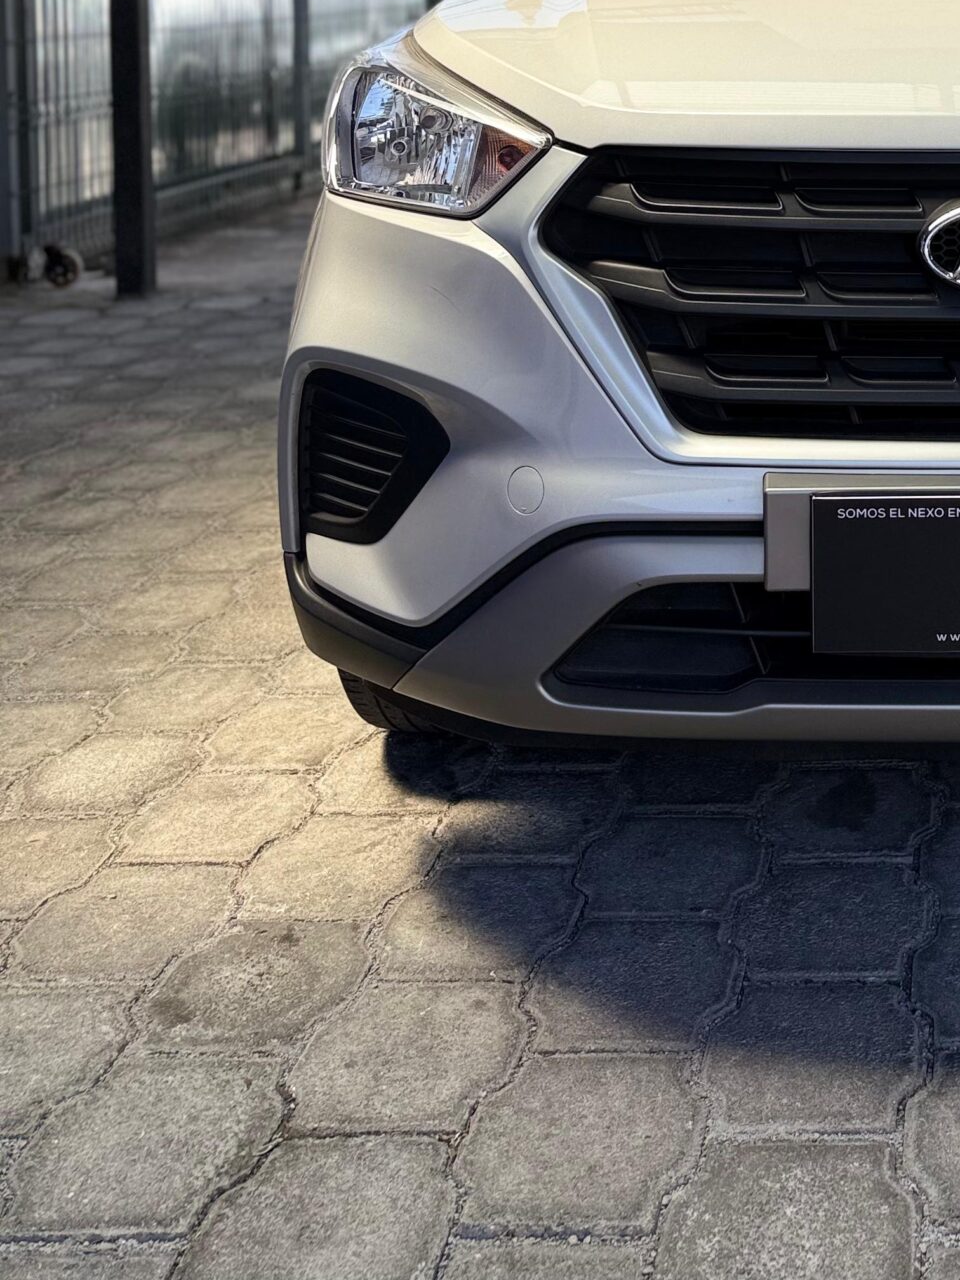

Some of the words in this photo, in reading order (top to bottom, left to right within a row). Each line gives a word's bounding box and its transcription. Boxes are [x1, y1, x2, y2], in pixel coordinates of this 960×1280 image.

[837, 508, 886, 519] SOMOS
[889, 508, 905, 518] EL
[908, 507, 945, 518] NEXO
